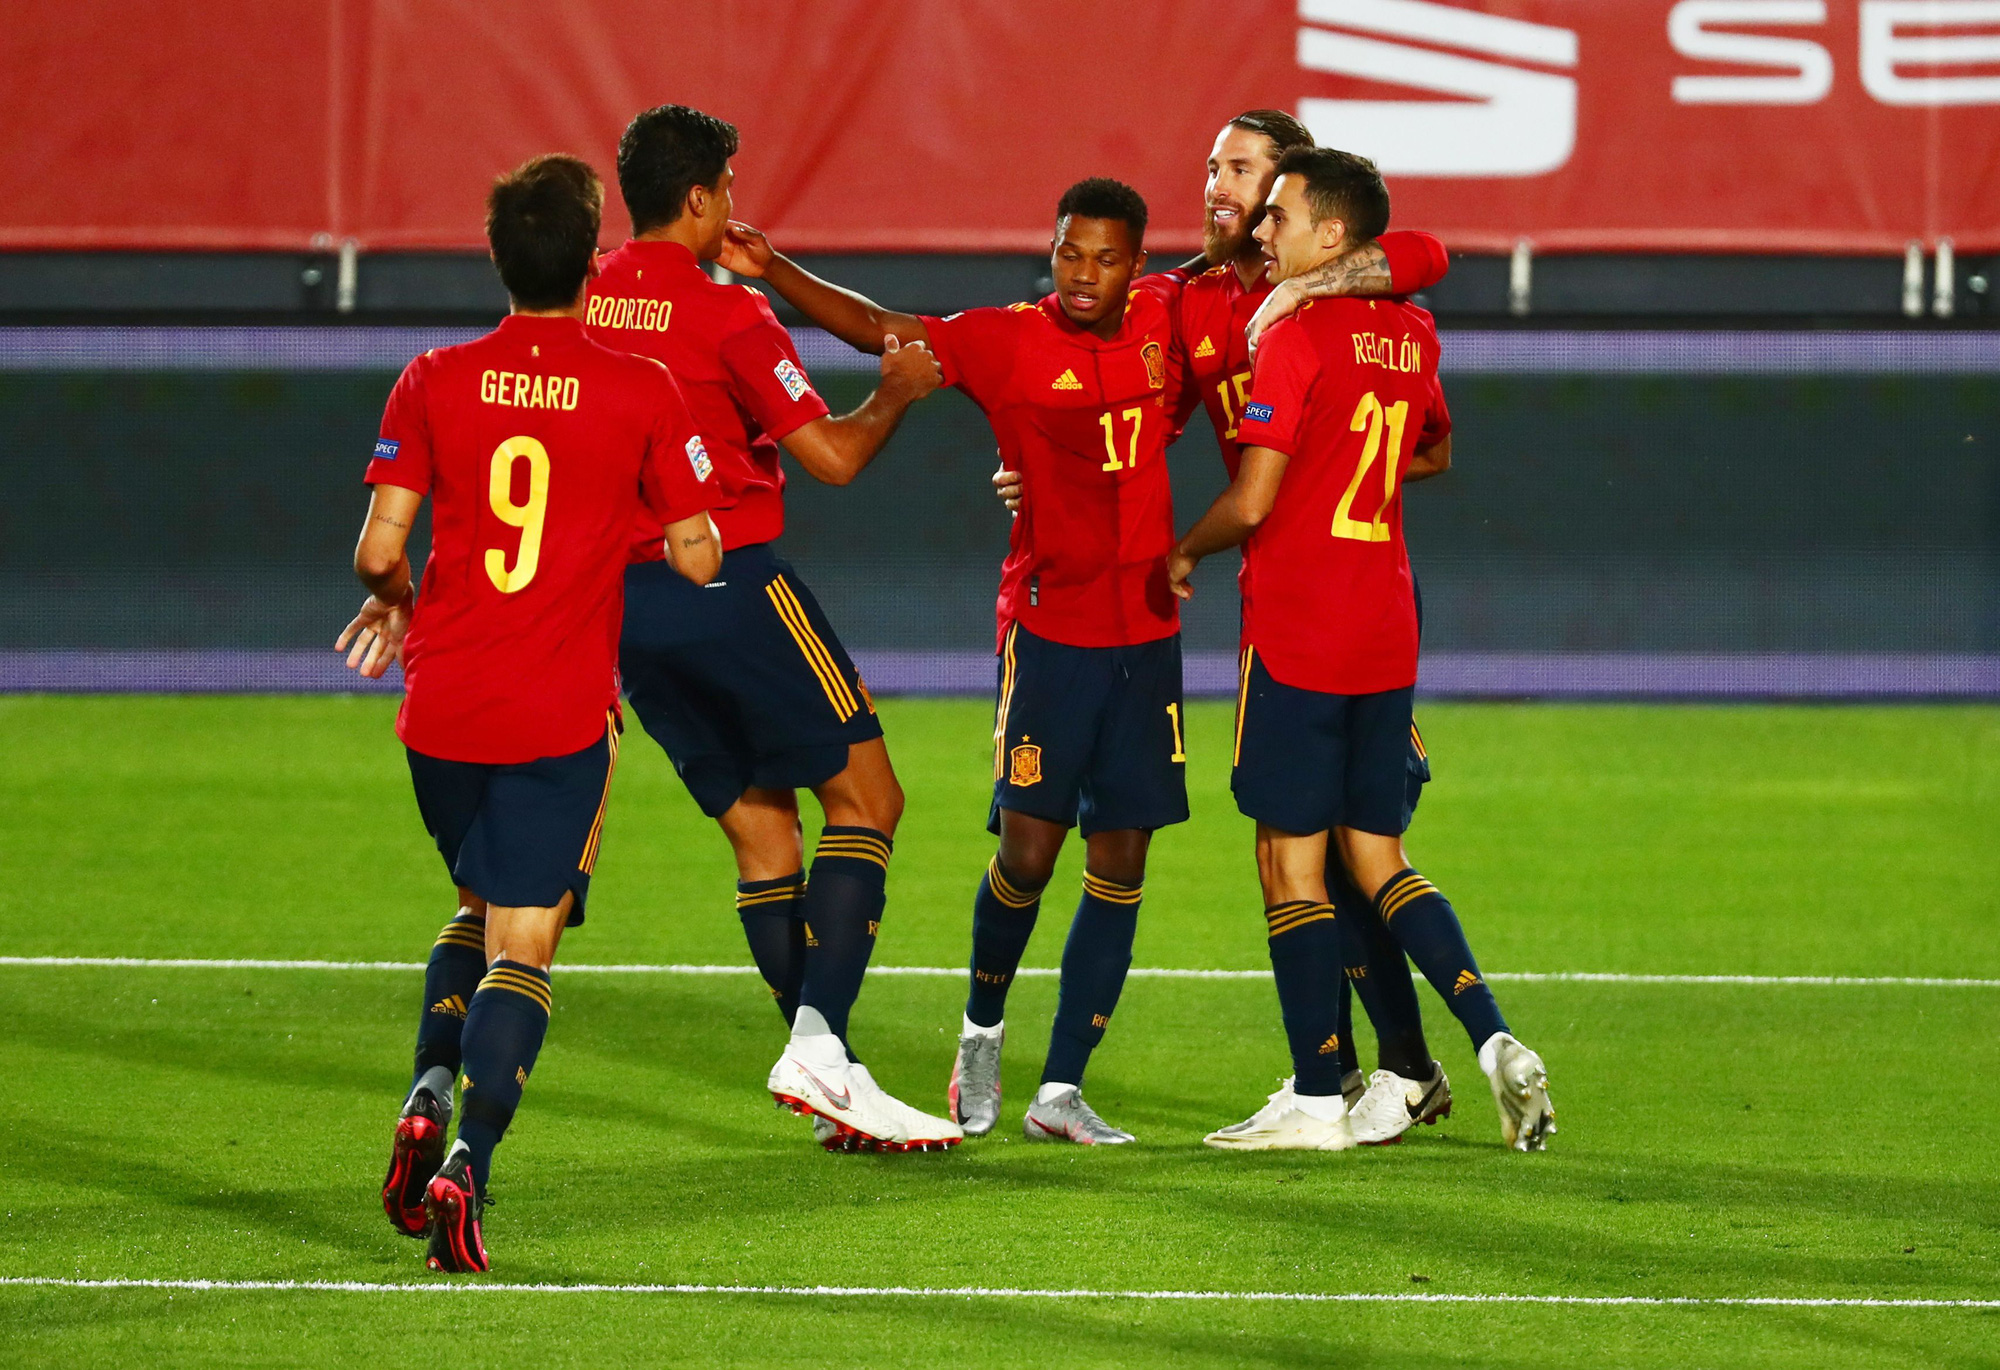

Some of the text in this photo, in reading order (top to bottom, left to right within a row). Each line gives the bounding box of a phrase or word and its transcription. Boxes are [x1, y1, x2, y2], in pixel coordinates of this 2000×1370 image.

[586, 295, 673, 332] RODRIGO
[1194, 348, 1216, 358] adidas
[480, 369, 580, 411] GERARD
[1051, 382, 1083, 390] adidas
[1099, 407, 1142, 472] 17
[1331, 391, 1409, 542] 21
[485, 435, 551, 593] 9
